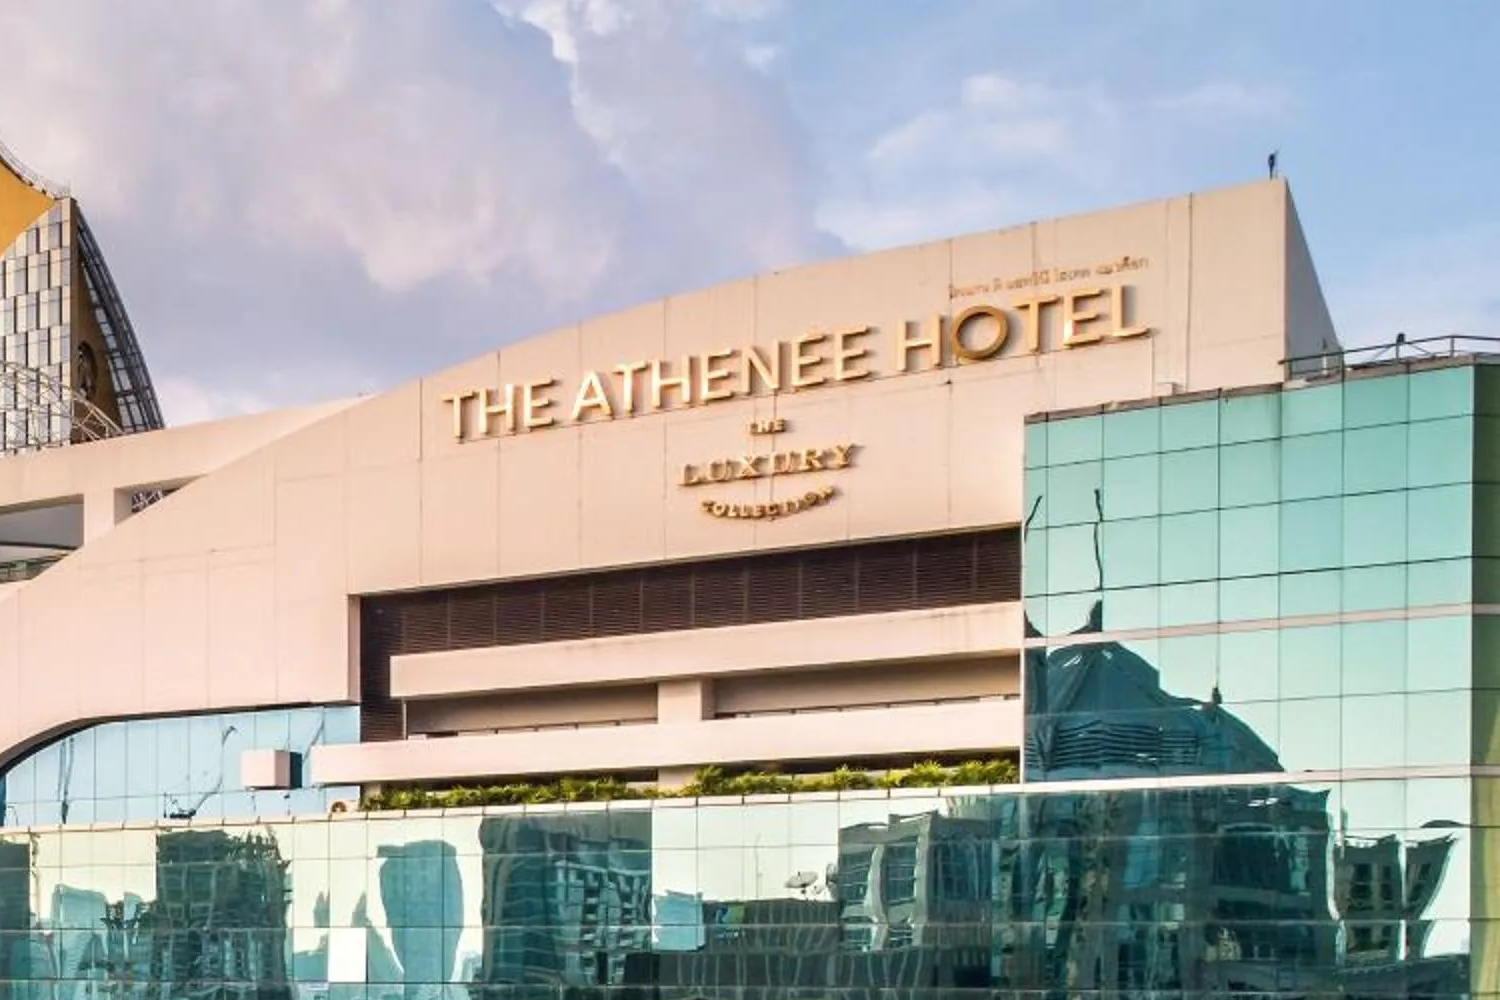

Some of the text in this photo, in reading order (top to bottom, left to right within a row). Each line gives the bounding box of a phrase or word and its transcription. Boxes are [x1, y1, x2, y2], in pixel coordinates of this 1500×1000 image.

[443, 378, 558, 444] THE
[897, 282, 1153, 373] HOTEL
[747, 418, 788, 435] THE
[680, 443, 859, 487] LUXURY
[701, 483, 838, 520] COLLECTION
